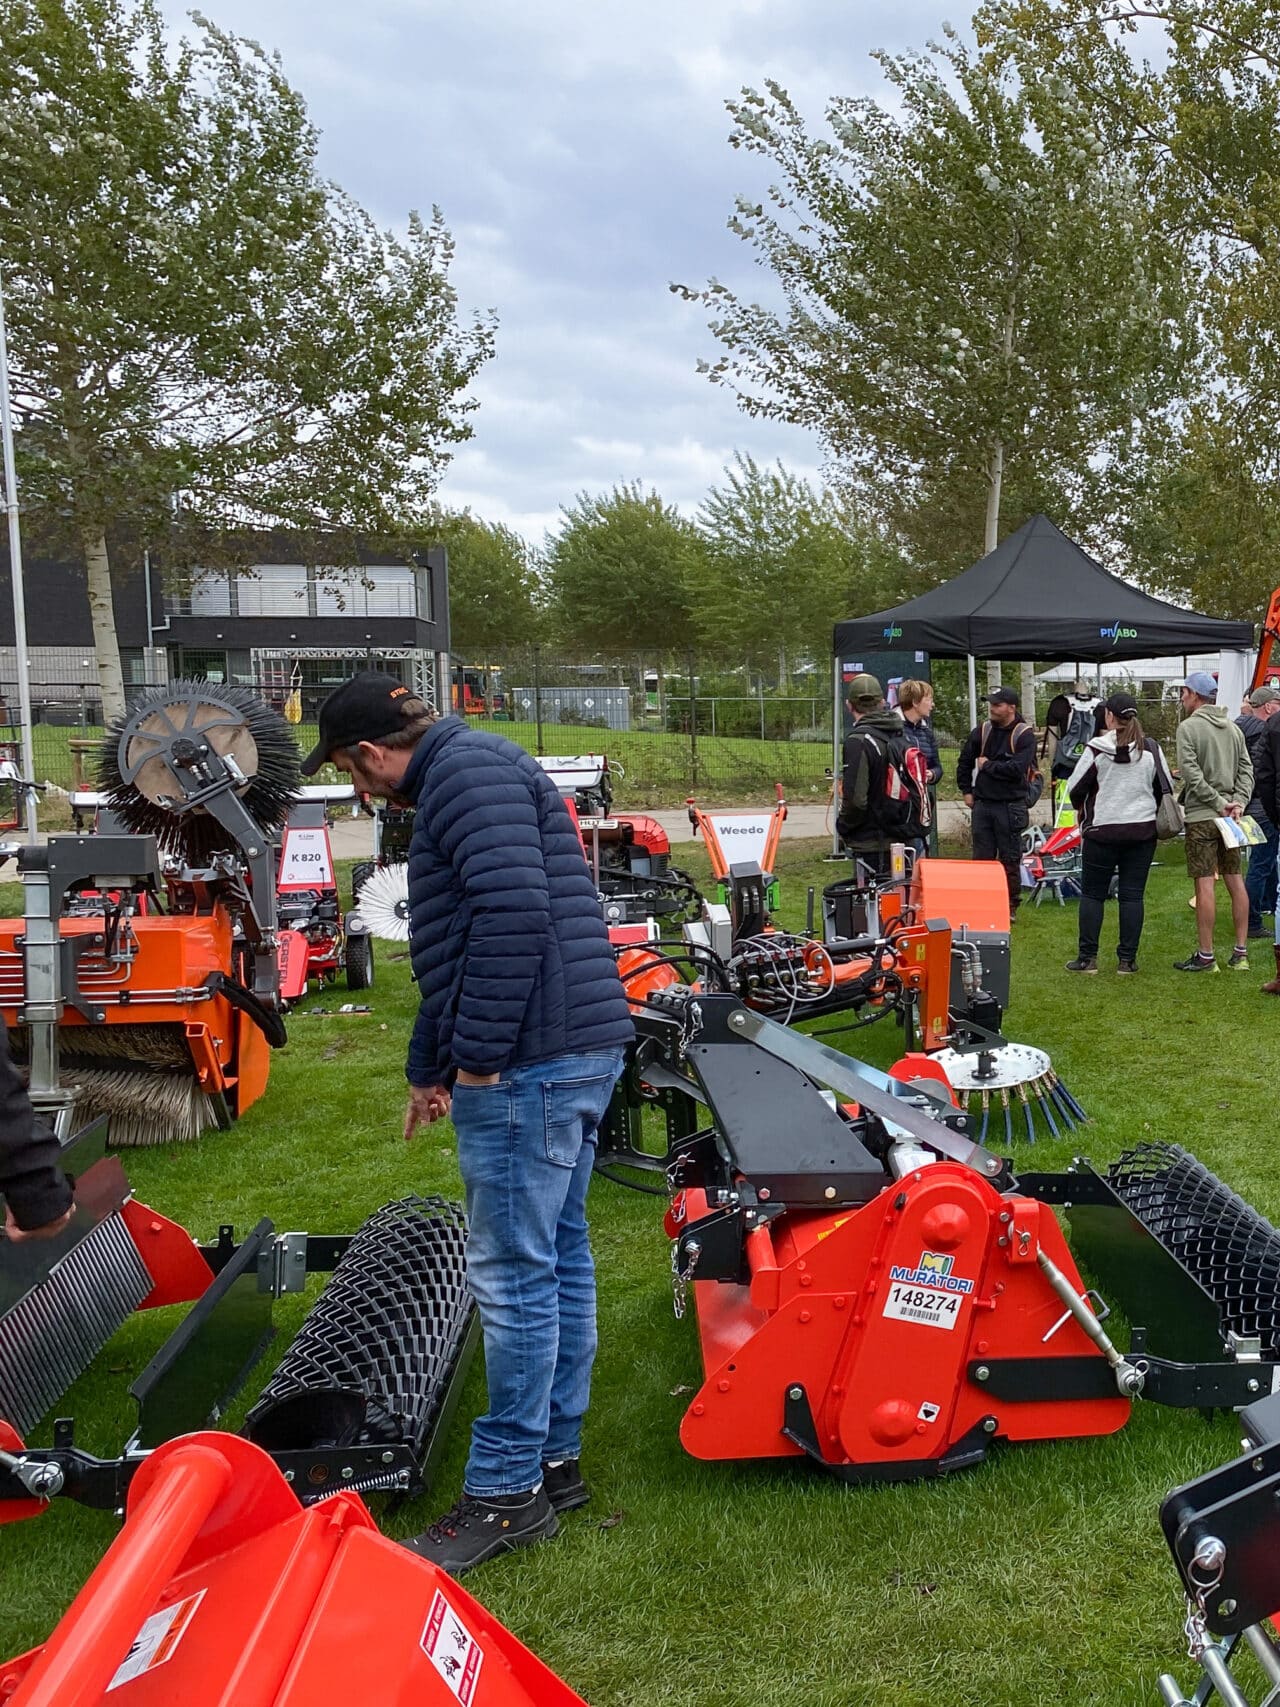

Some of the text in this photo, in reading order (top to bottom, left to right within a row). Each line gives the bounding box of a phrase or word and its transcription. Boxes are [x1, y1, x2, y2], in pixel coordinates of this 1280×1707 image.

[720, 826, 764, 834] Weedo
[292, 853, 321, 862] K 820
[891, 1267, 973, 1293] MURATORI
[893, 1288, 957, 1314] 148274
